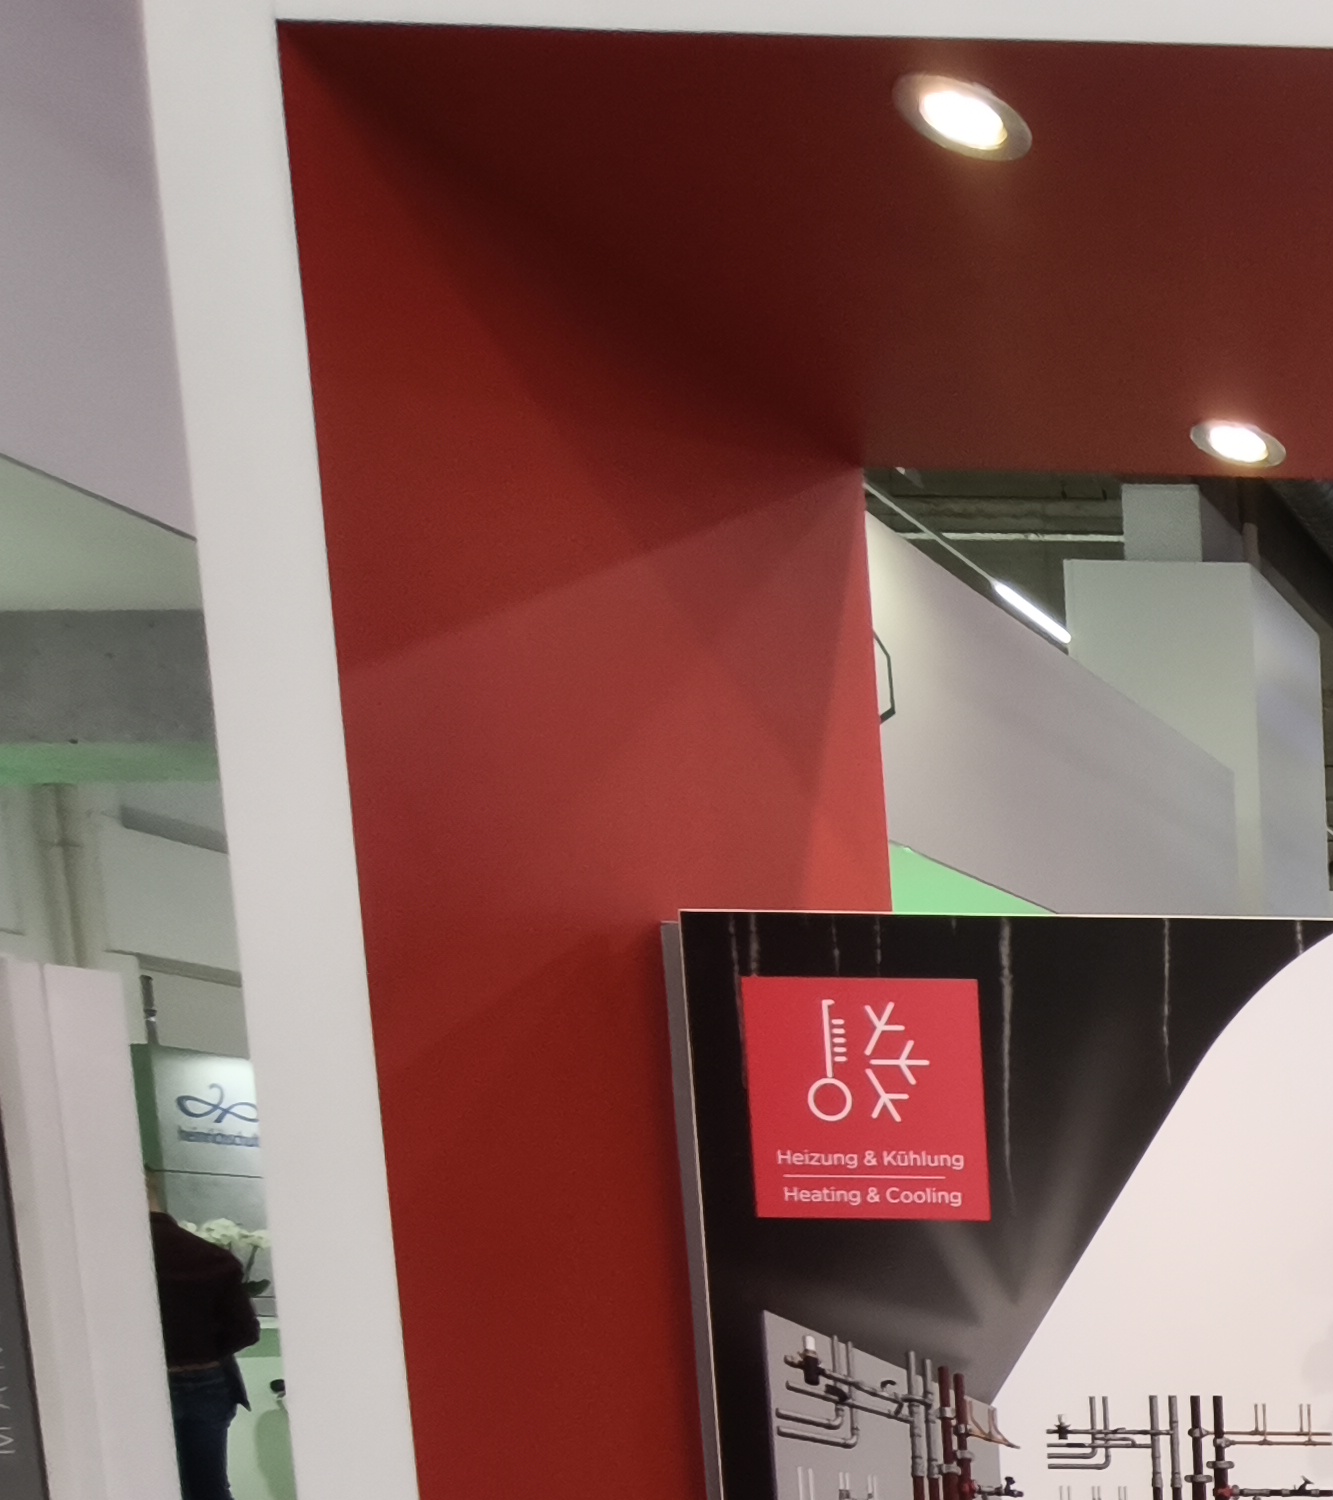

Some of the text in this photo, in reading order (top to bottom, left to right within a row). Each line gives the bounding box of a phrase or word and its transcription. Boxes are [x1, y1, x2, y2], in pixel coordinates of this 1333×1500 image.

[777, 1149, 965, 1170] Heizung & Kühlung
[783, 1187, 962, 1207] Heating & Cooling
